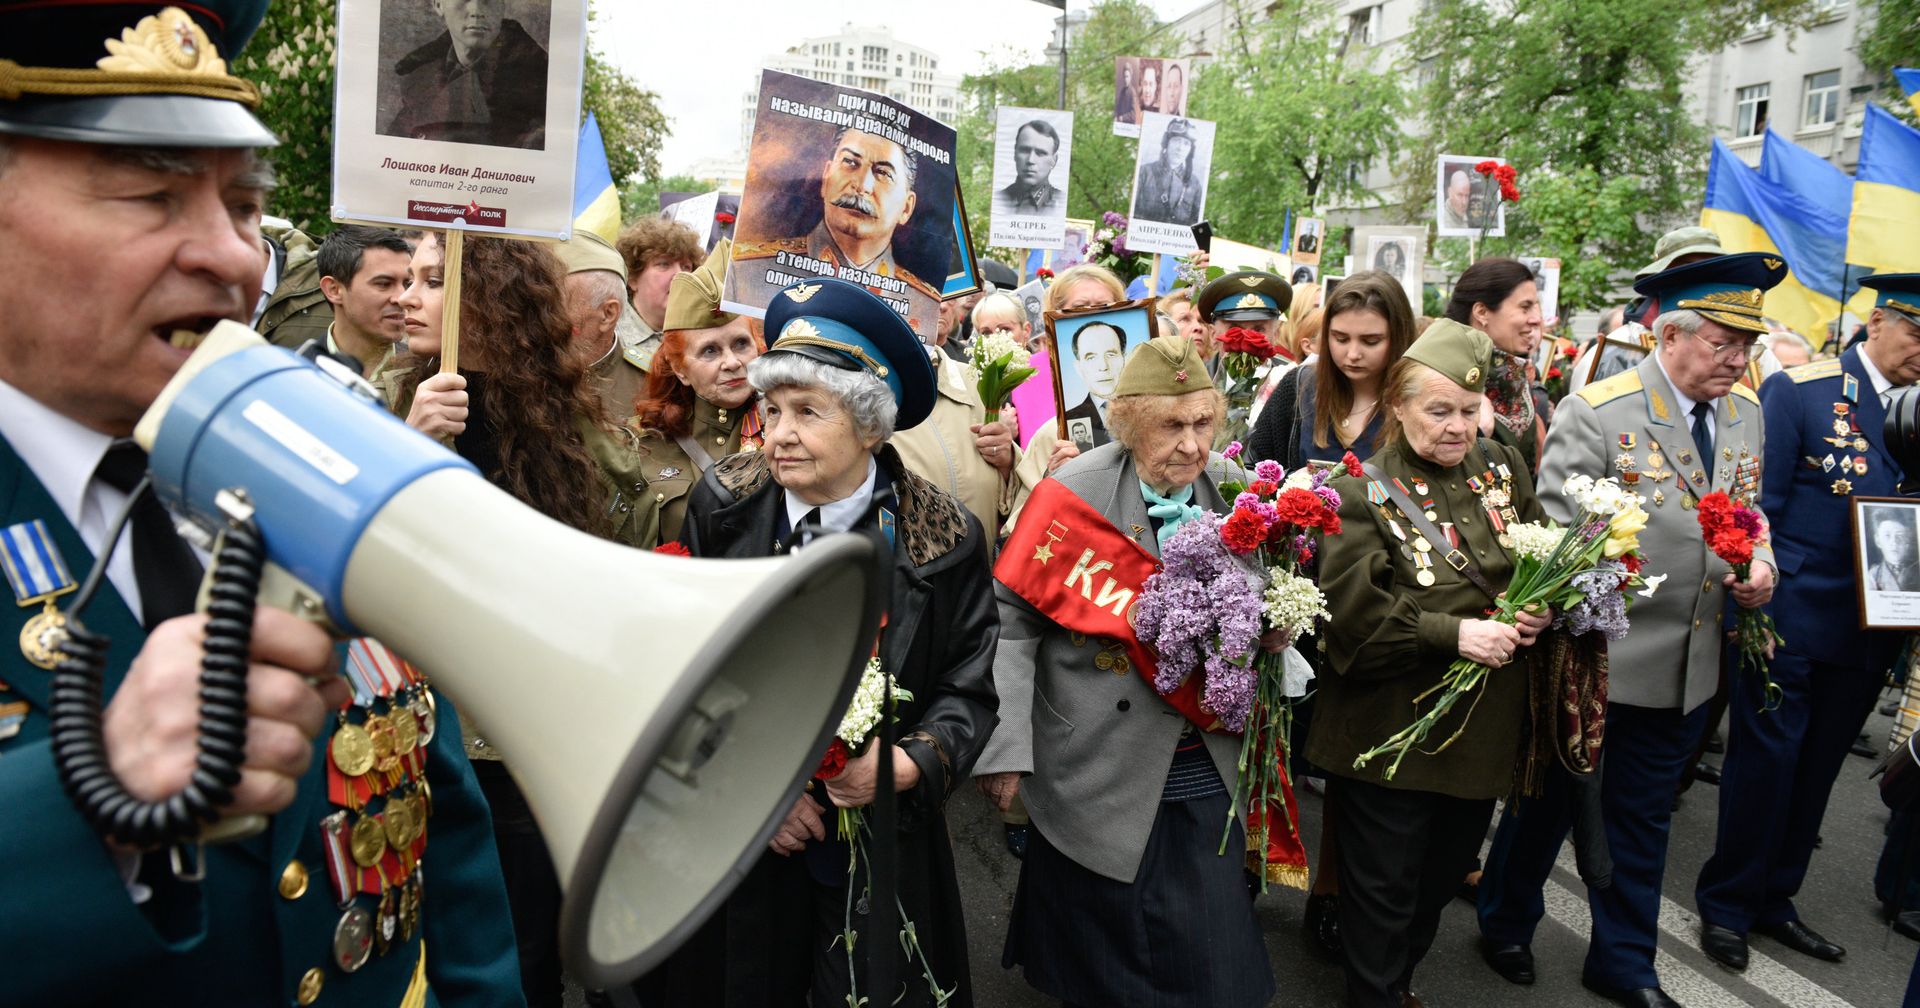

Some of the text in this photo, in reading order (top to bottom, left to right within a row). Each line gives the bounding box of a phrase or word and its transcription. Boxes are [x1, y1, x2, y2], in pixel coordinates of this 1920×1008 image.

[837, 93, 911, 128] при мне их
[770, 96, 950, 165] называли врагами народа
[381, 157, 536, 184] Лошаков Иван Данилович
[409, 176, 508, 195] капитан 2-го ранга
[1010, 220, 1047, 231] ЯСТРЕБ
[776, 250, 908, 294] а теперь называют
